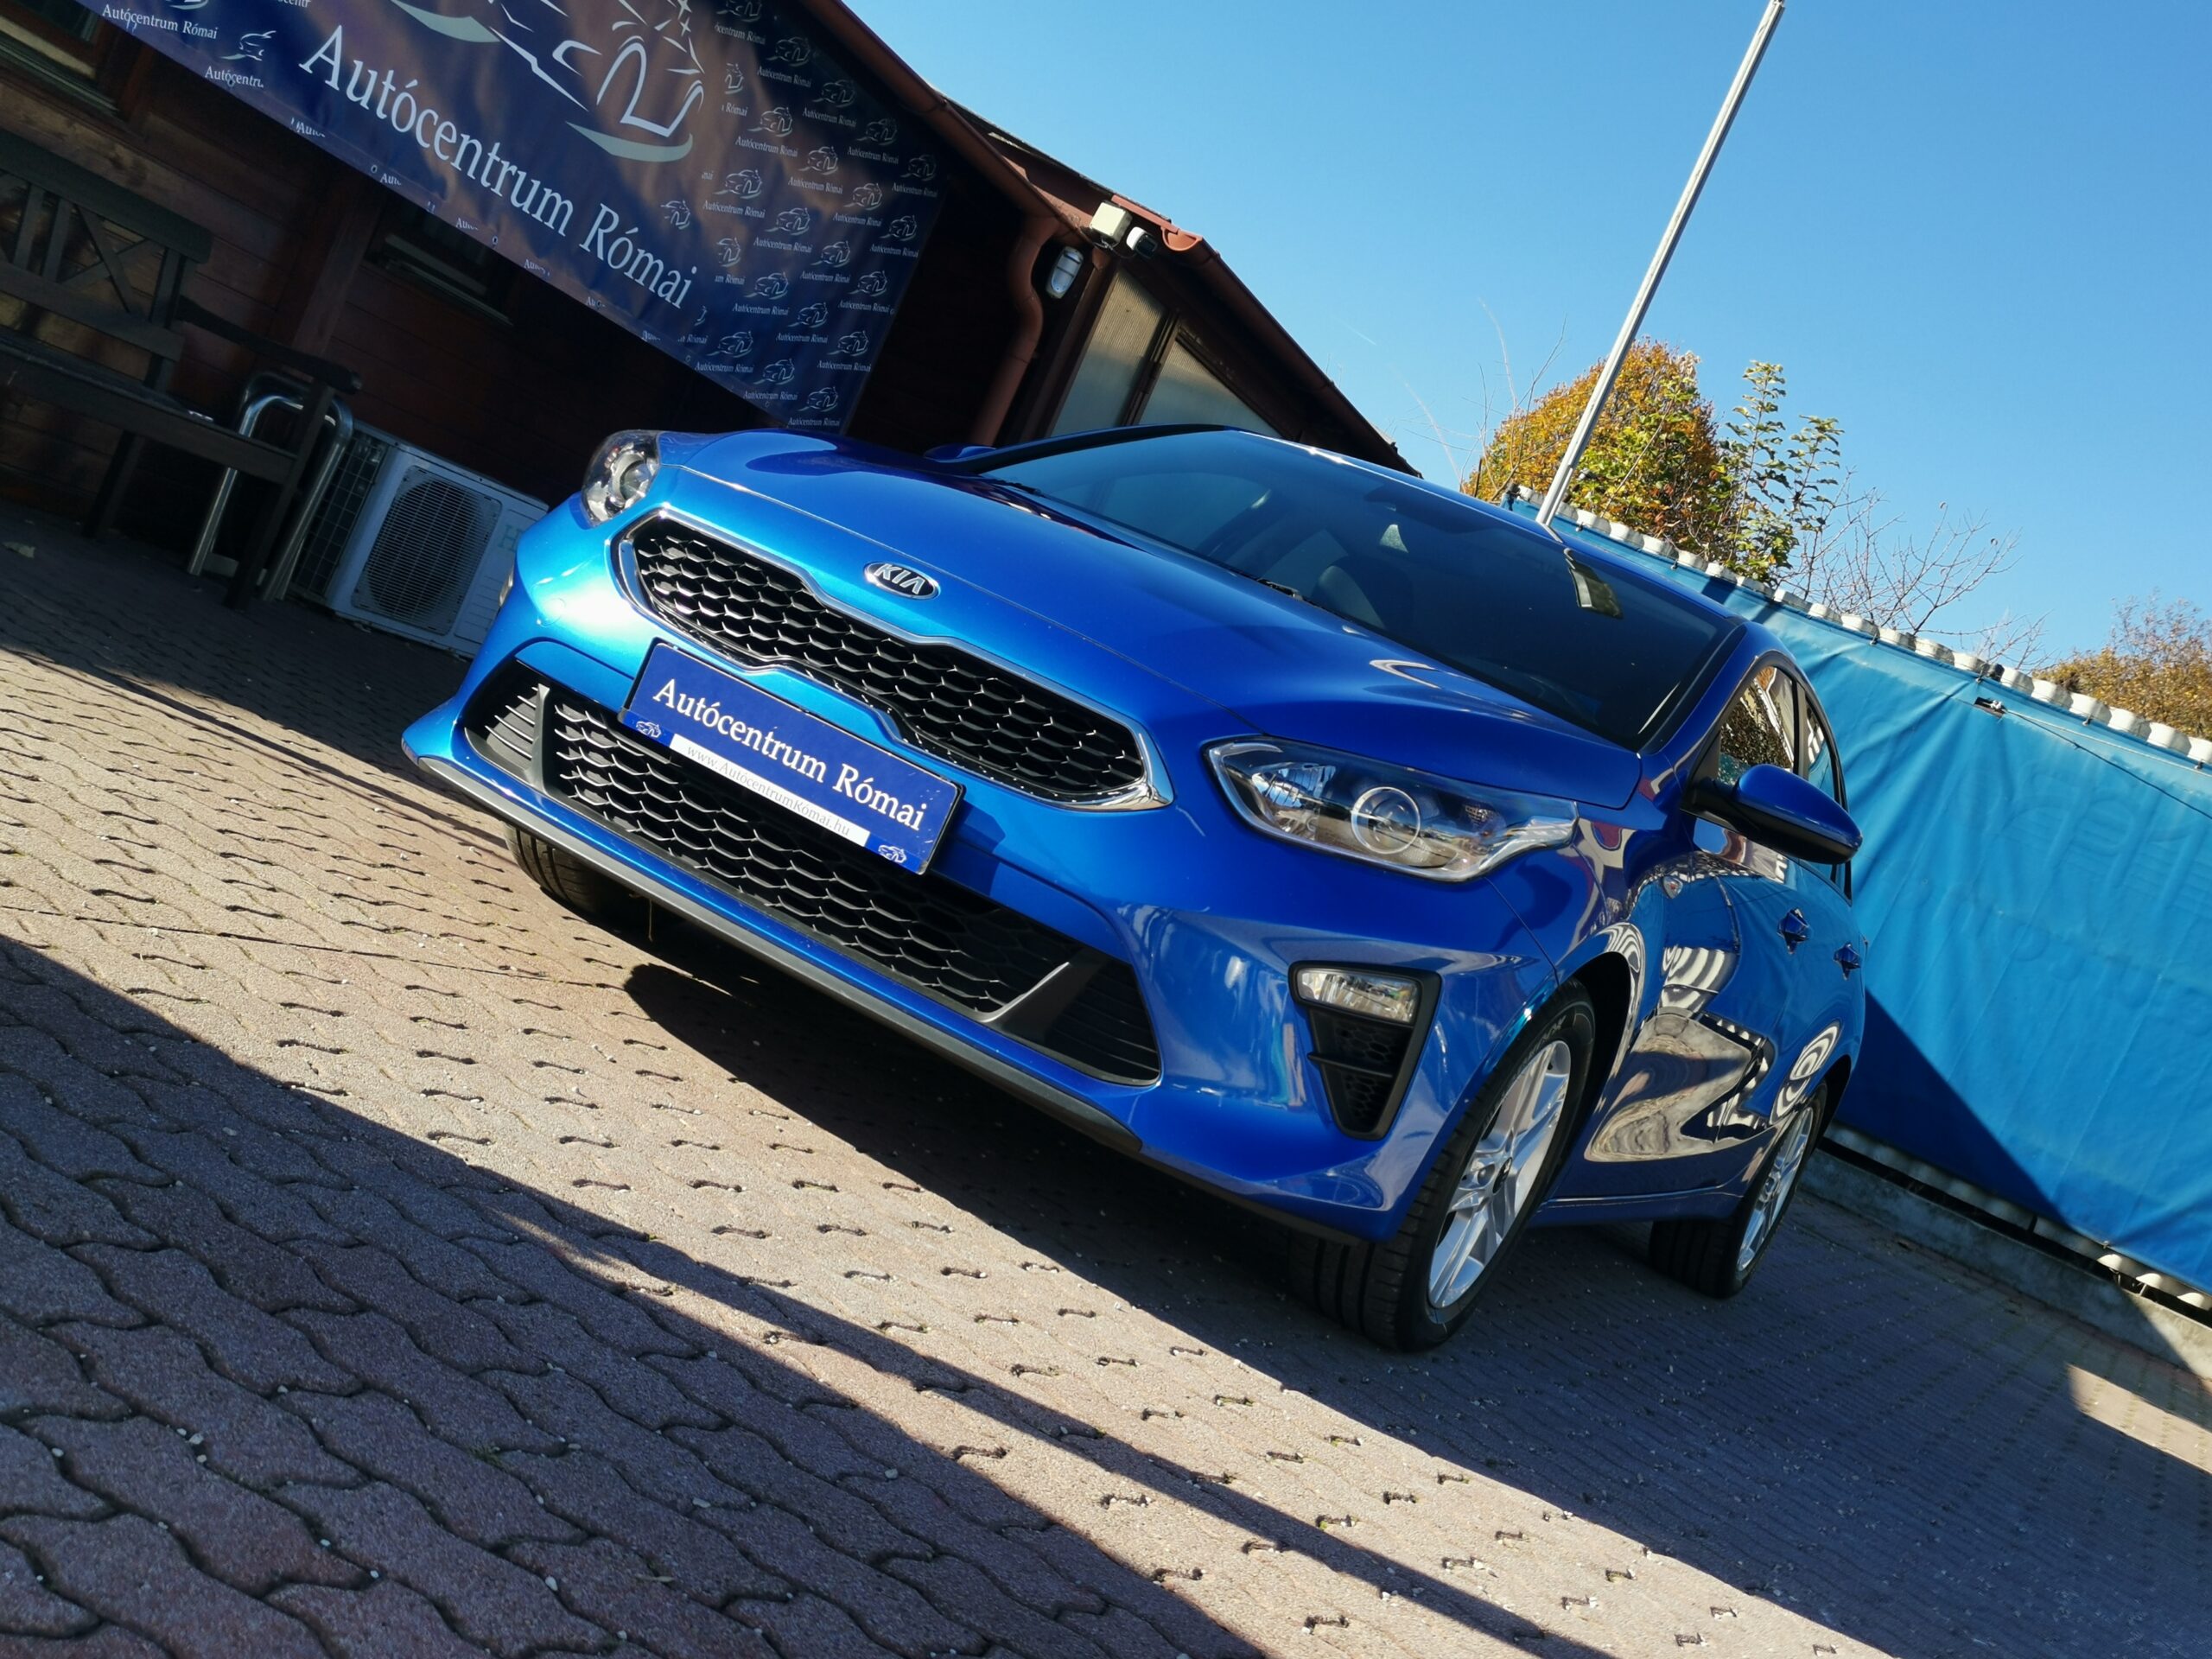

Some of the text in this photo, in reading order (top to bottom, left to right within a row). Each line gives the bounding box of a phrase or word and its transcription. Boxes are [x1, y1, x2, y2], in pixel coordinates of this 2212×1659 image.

[101, 4, 219, 40] Autócentrum Római
[298, 24, 697, 309] Autócentrum Római
[874, 563, 926, 595] KIA
[652, 678, 928, 832] Autócentrum Római
